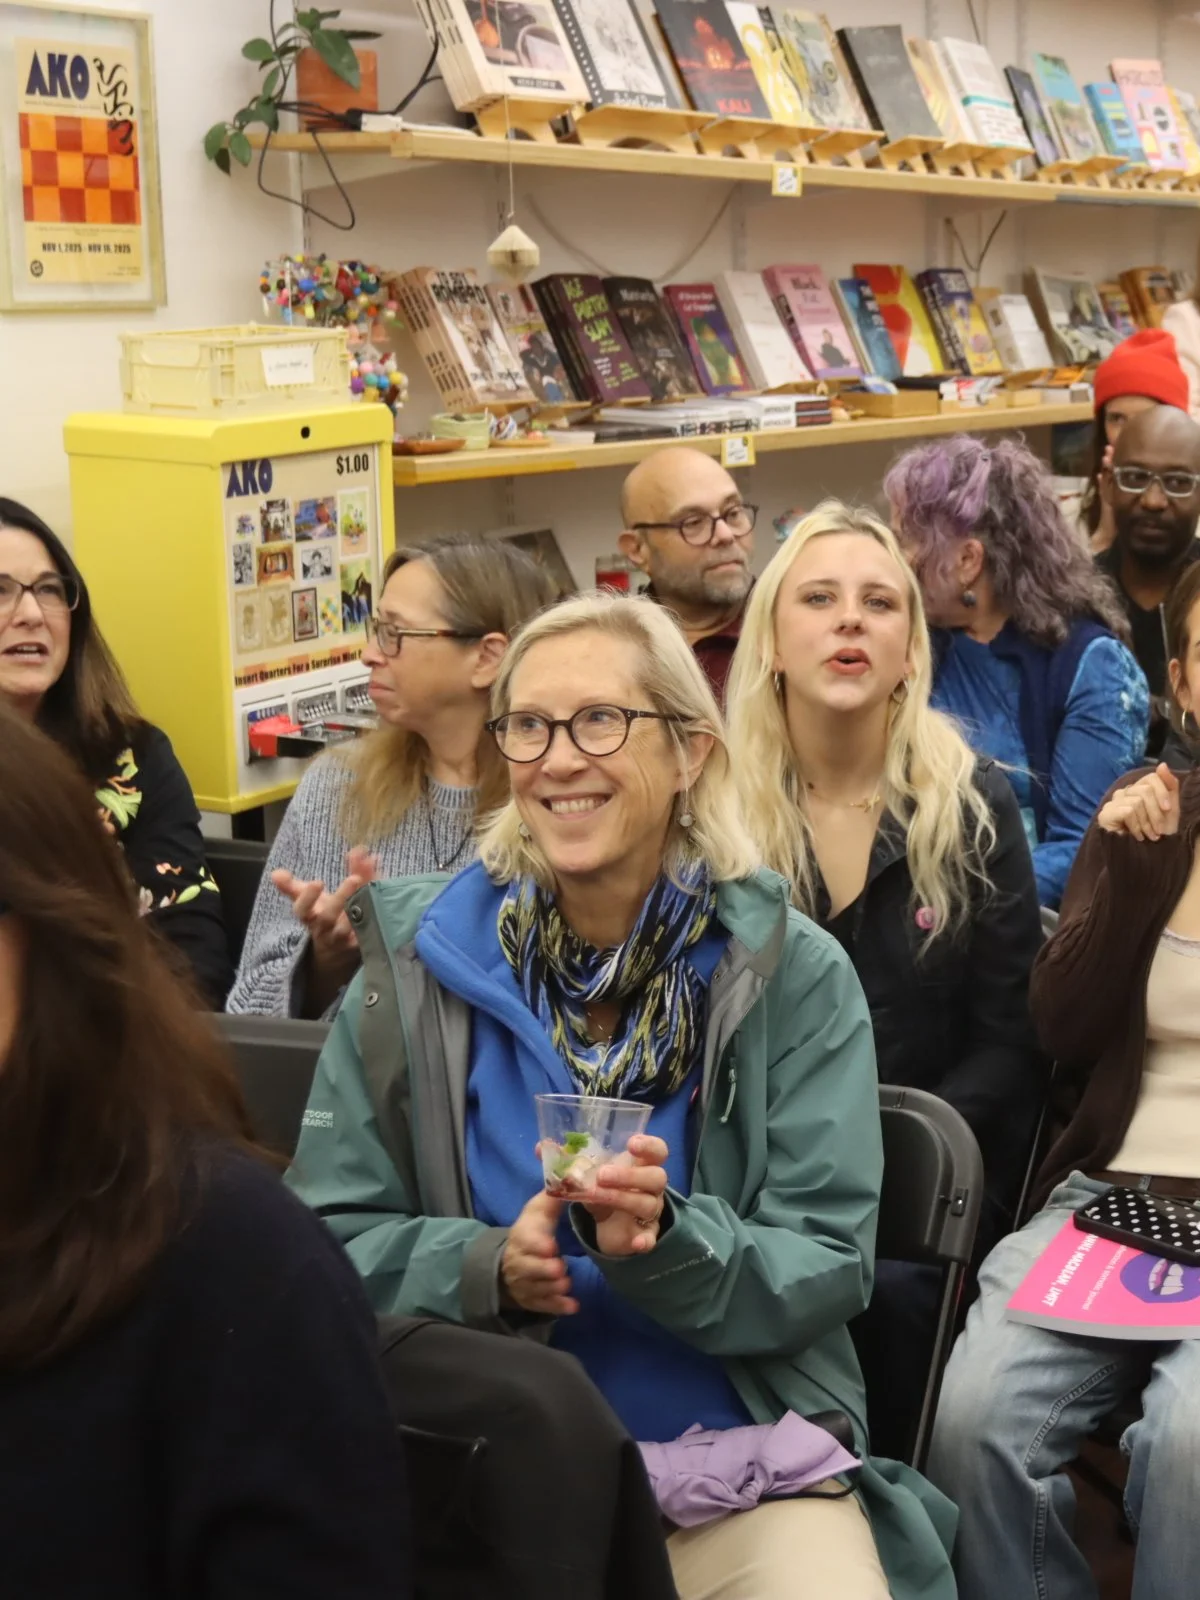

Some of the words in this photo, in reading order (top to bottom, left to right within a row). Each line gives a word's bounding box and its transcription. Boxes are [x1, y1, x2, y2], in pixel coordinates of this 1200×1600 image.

[25, 49, 90, 101] AKO
[42, 242, 56, 253] NOV
[88, 243, 101, 253] NOV
[226, 458, 273, 499] AKO
[336, 454, 370, 476] $1.00
[234, 673, 259, 687] Insert
[259, 665, 292, 682] Quarters
[311, 655, 341, 670] Surprise
